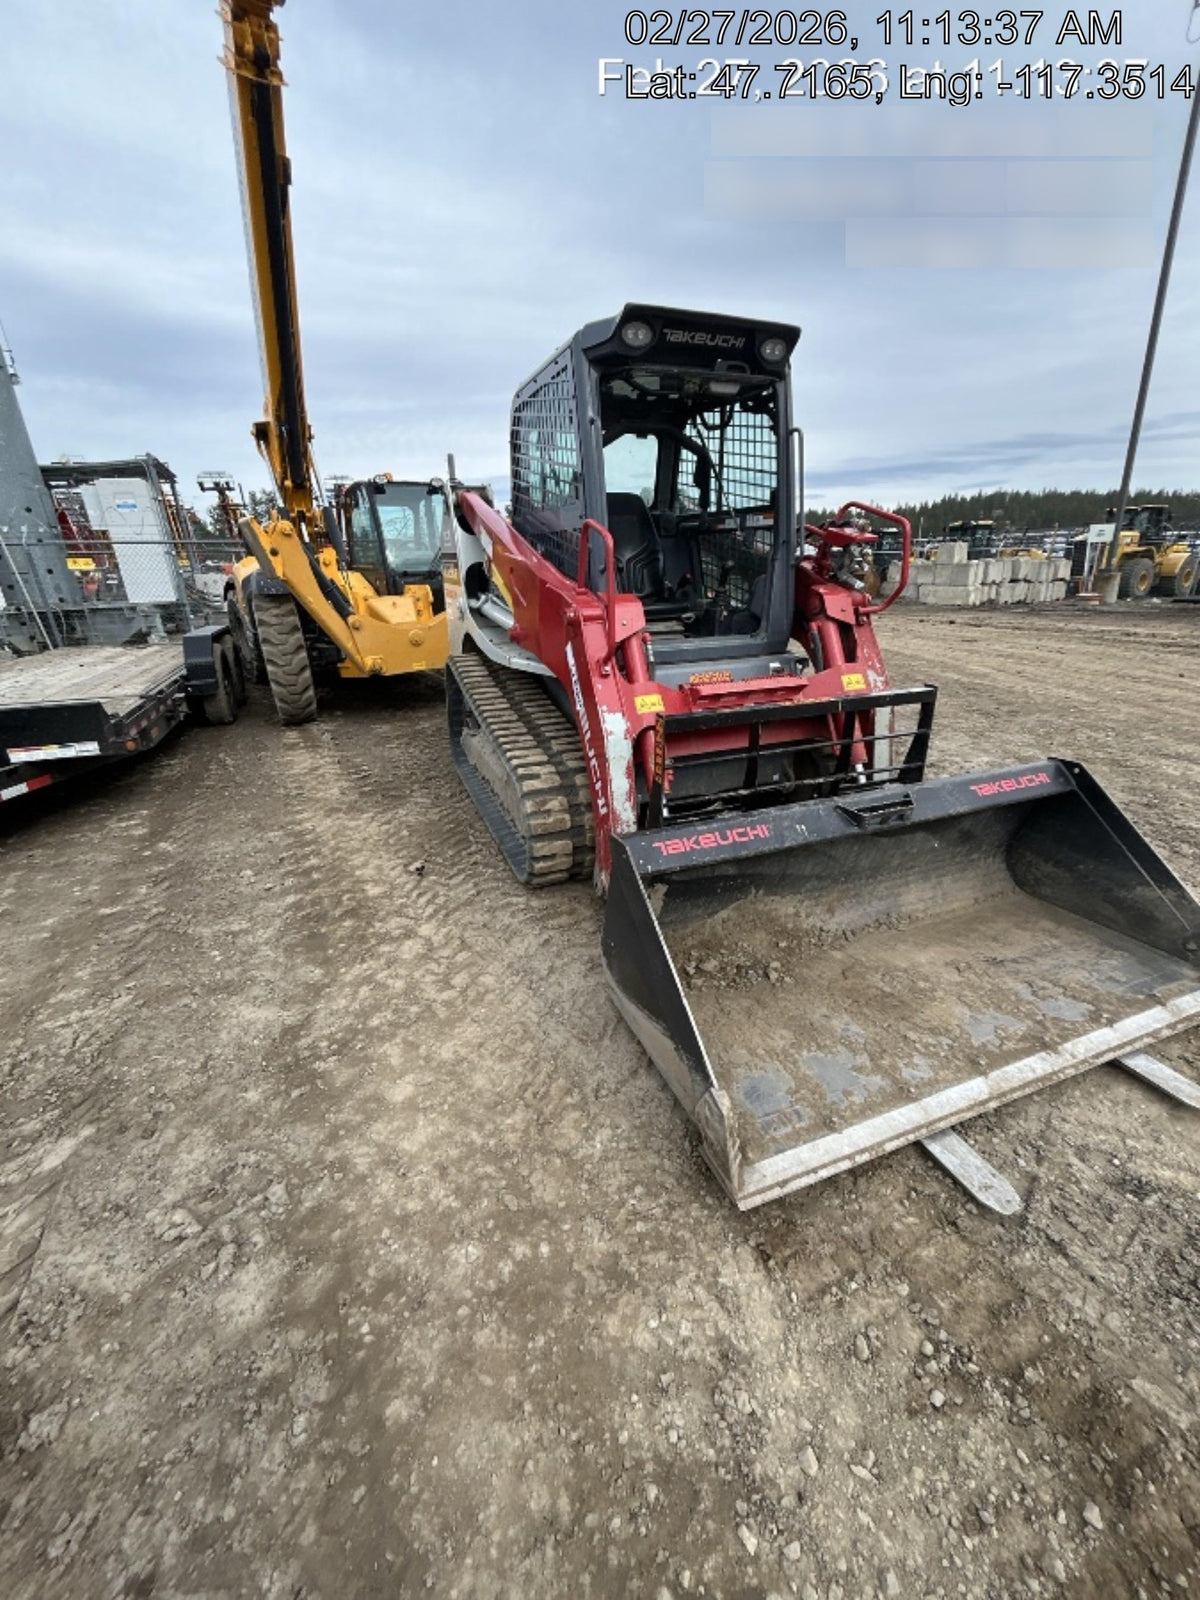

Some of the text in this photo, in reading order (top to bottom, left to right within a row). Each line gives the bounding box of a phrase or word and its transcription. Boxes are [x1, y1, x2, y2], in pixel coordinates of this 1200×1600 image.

[662, 328, 746, 349] TAKEUCHI
[968, 772, 1052, 798] TAKEUCHI
[652, 824, 770, 856] TAKEUCHI
